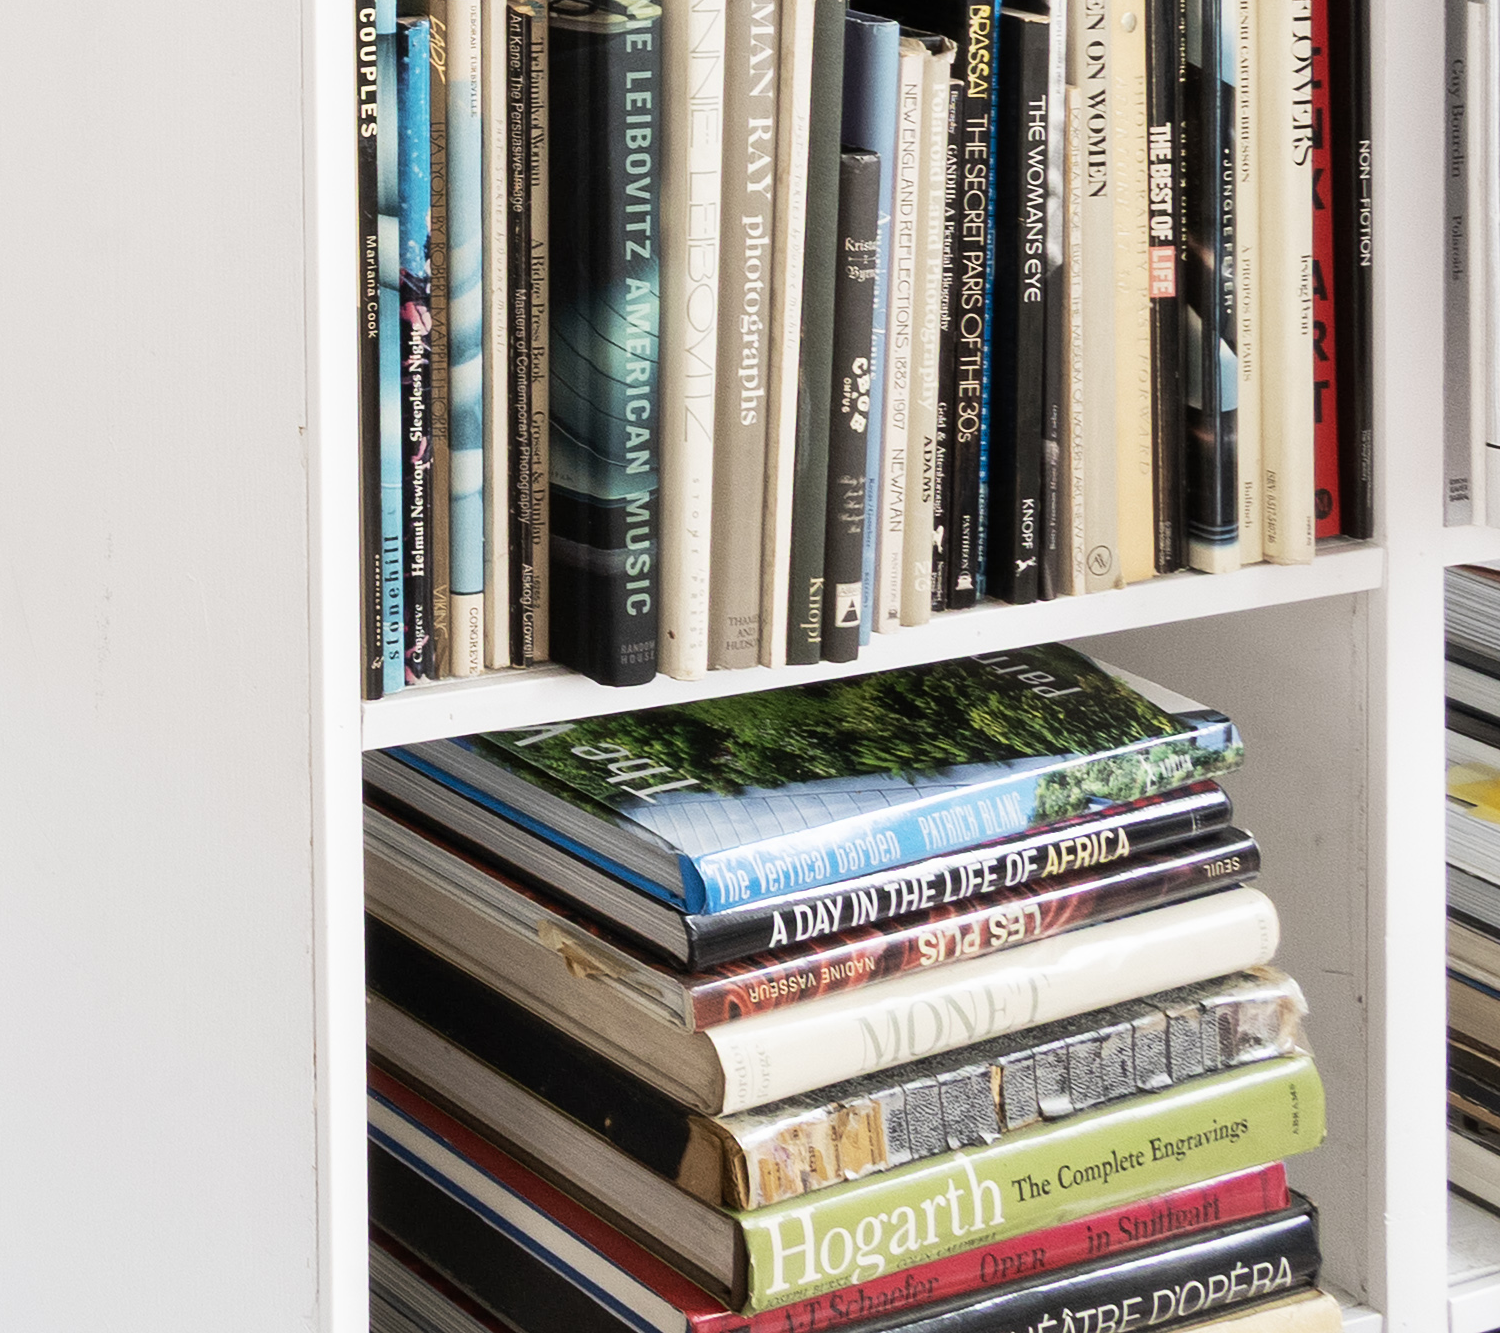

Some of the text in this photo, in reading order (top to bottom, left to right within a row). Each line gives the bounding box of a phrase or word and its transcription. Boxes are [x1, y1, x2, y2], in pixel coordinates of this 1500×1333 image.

[358, 4, 377, 141] COUPLES
[624, 68, 652, 263] LEIBOVITZ
[739, 0, 775, 429] MAN RAY photographs
[1149, 121, 1174, 295] THE BEST OF LIFE
[622, 280, 652, 475] AMERICAN
[621, 494, 652, 617] MUSIC
[764, 825, 1134, 947] A DAY IN THE LIFE OF AFRICA
[858, 973, 1050, 1068] MONET
[763, 1117, 1253, 1295] Hogarth The Complete Engravings
